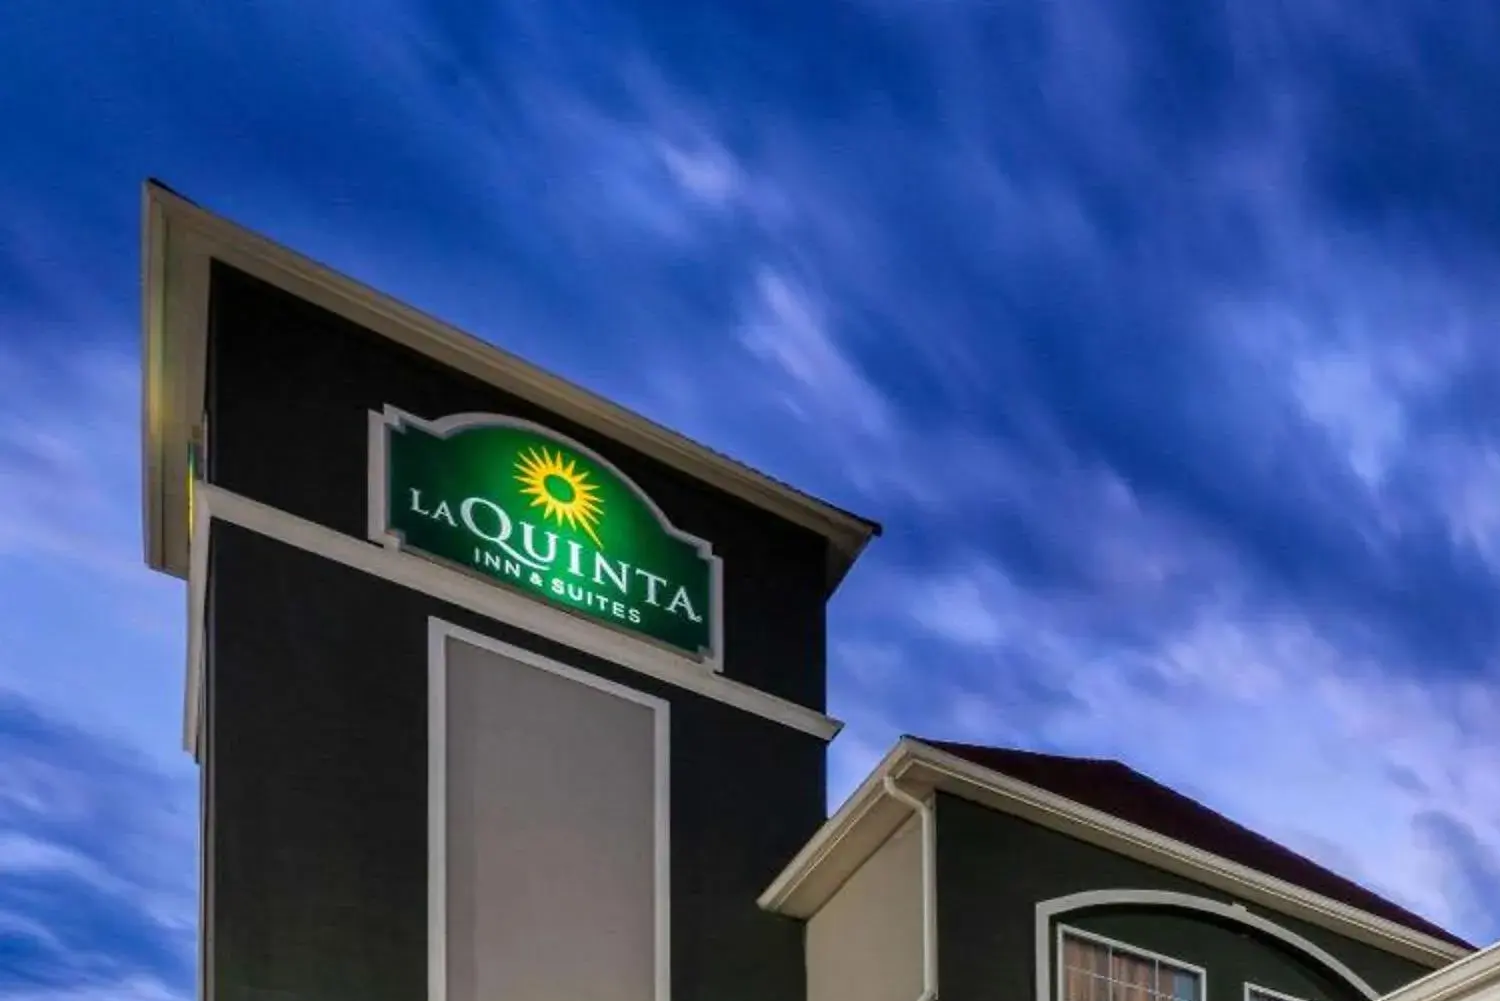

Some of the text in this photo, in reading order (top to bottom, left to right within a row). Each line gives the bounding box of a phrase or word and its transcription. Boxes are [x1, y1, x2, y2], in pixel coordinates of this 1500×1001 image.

[409, 487, 700, 622] LA QUINTA
[474, 547, 642, 624] INN & SUITES
